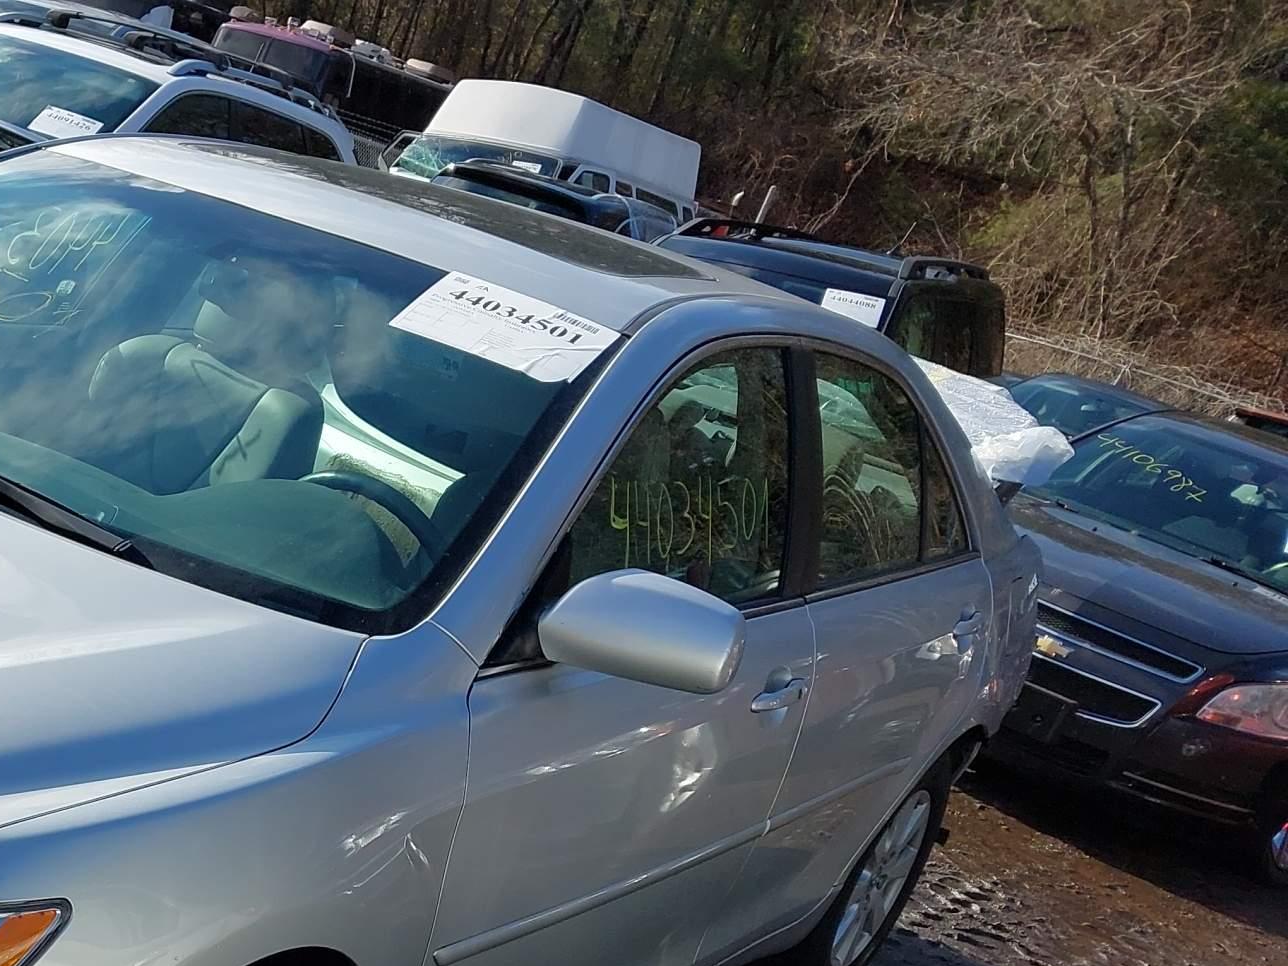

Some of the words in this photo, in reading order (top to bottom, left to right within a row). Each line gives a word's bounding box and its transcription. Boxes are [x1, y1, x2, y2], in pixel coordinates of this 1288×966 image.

[449, 289, 585, 345] 44034501
[1096, 432, 1208, 503] 44106987
[609, 474, 770, 568] 44034501
